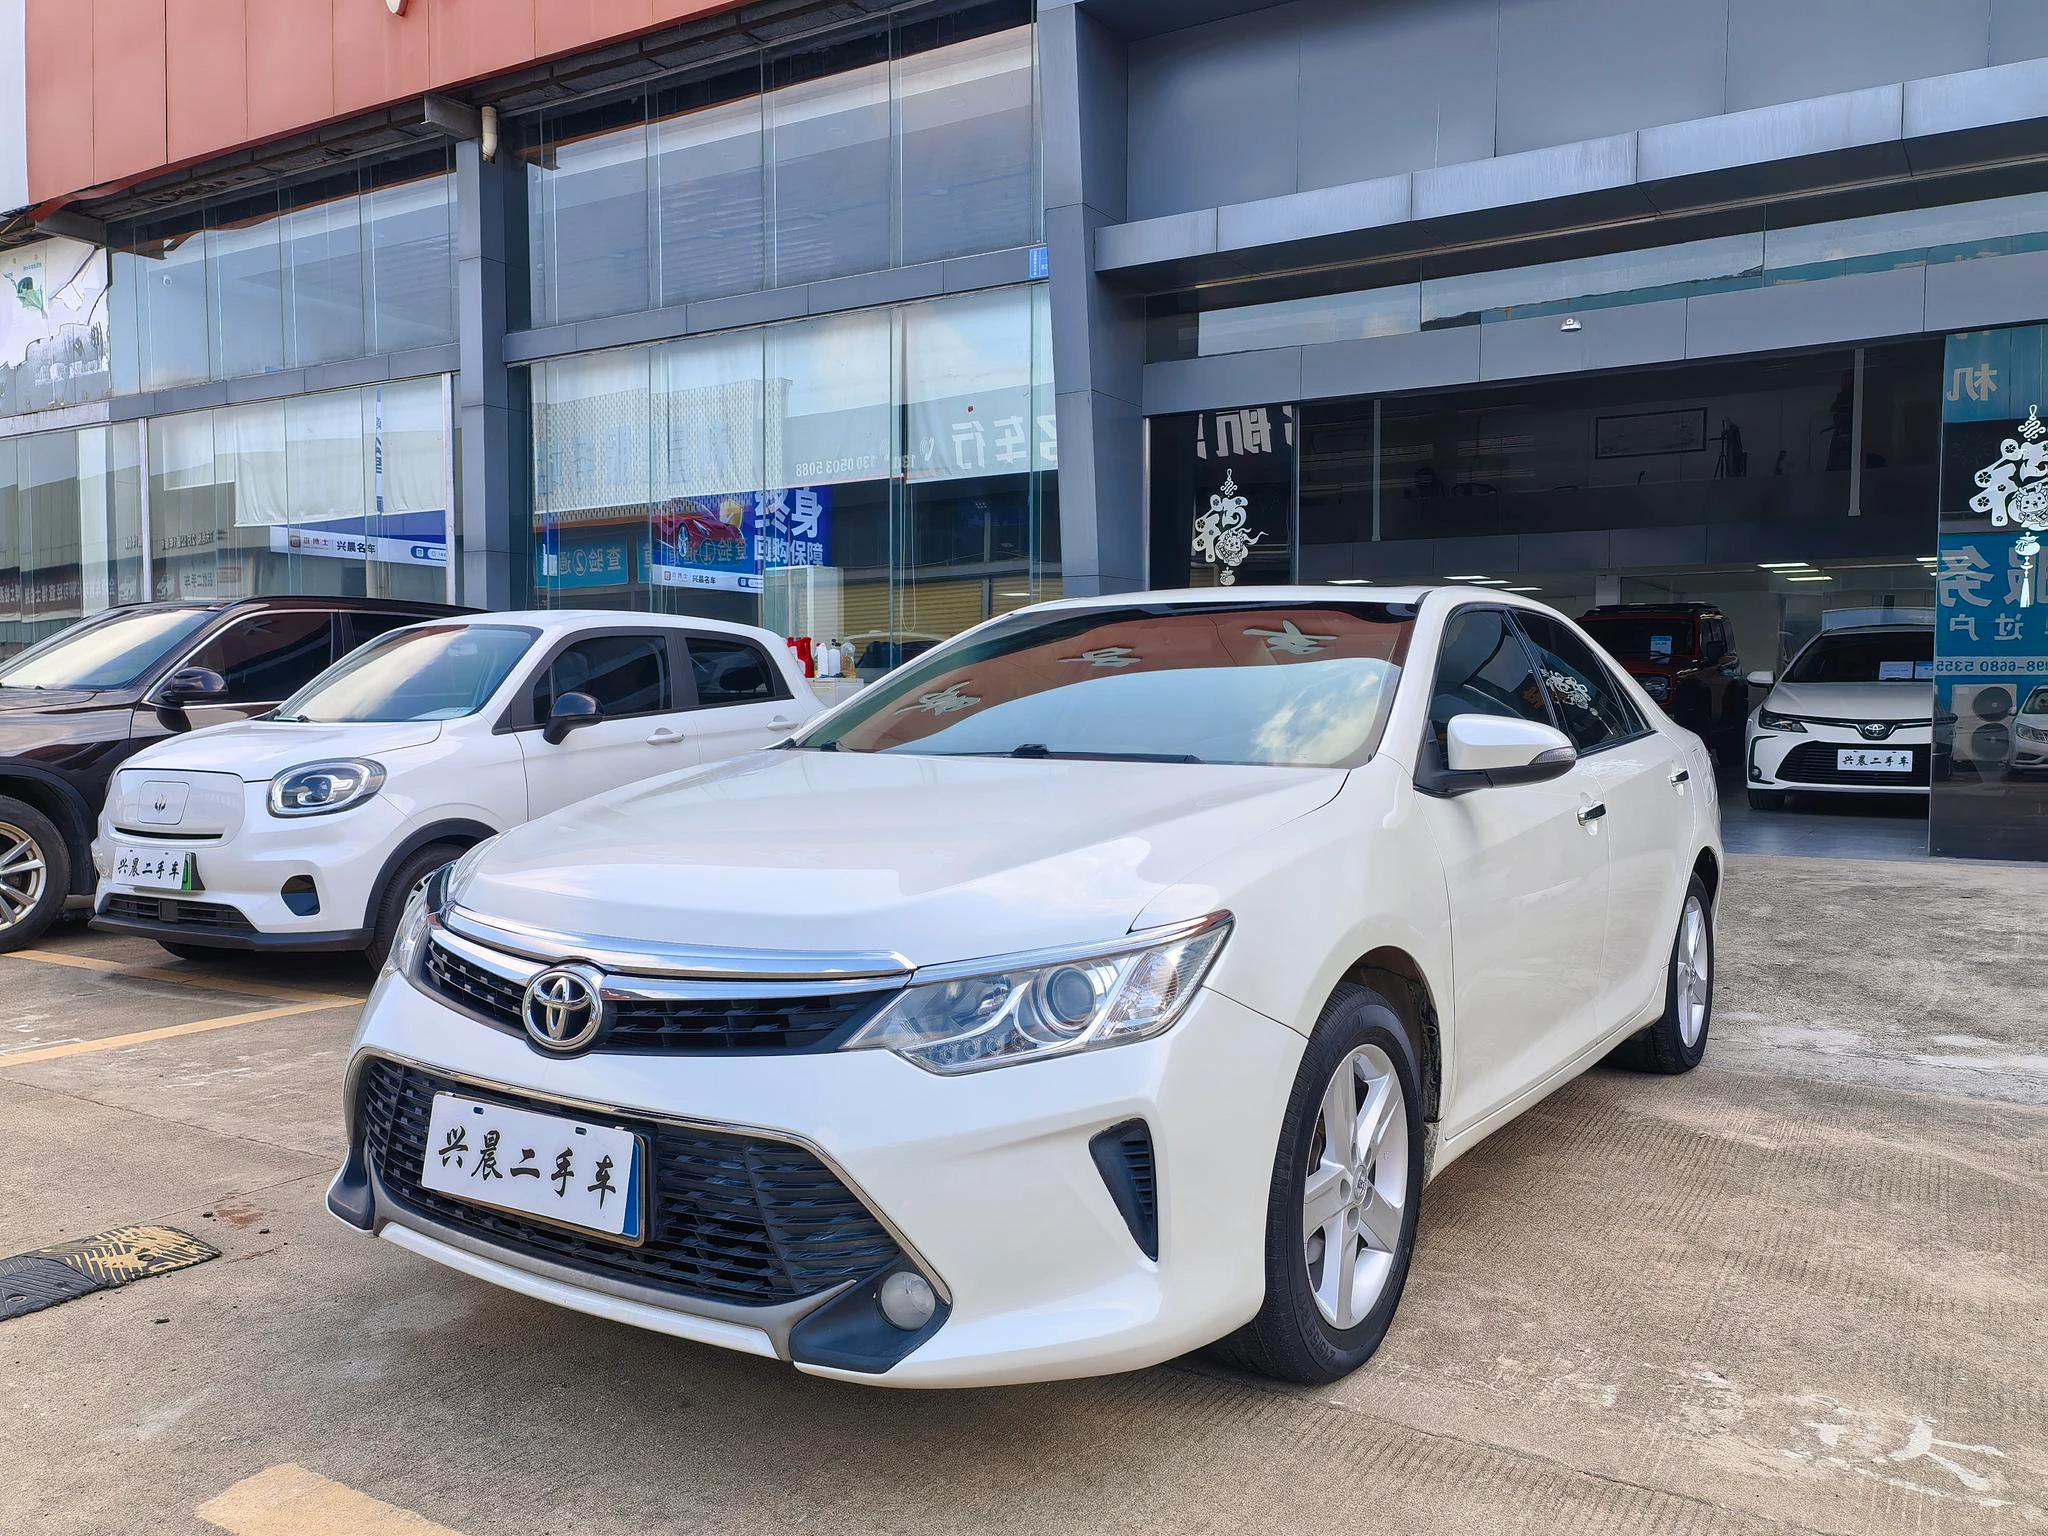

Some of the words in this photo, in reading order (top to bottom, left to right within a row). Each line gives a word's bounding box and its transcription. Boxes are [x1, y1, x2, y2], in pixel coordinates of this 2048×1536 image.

[336, 540, 377, 555] 兴晨名车
[754, 534, 824, 566] 回购保障
[1842, 754, 1909, 768] 兴晨二手车
[117, 857, 180, 881] 兴晨二手车
[438, 1125, 616, 1210] 兴晨二手车
